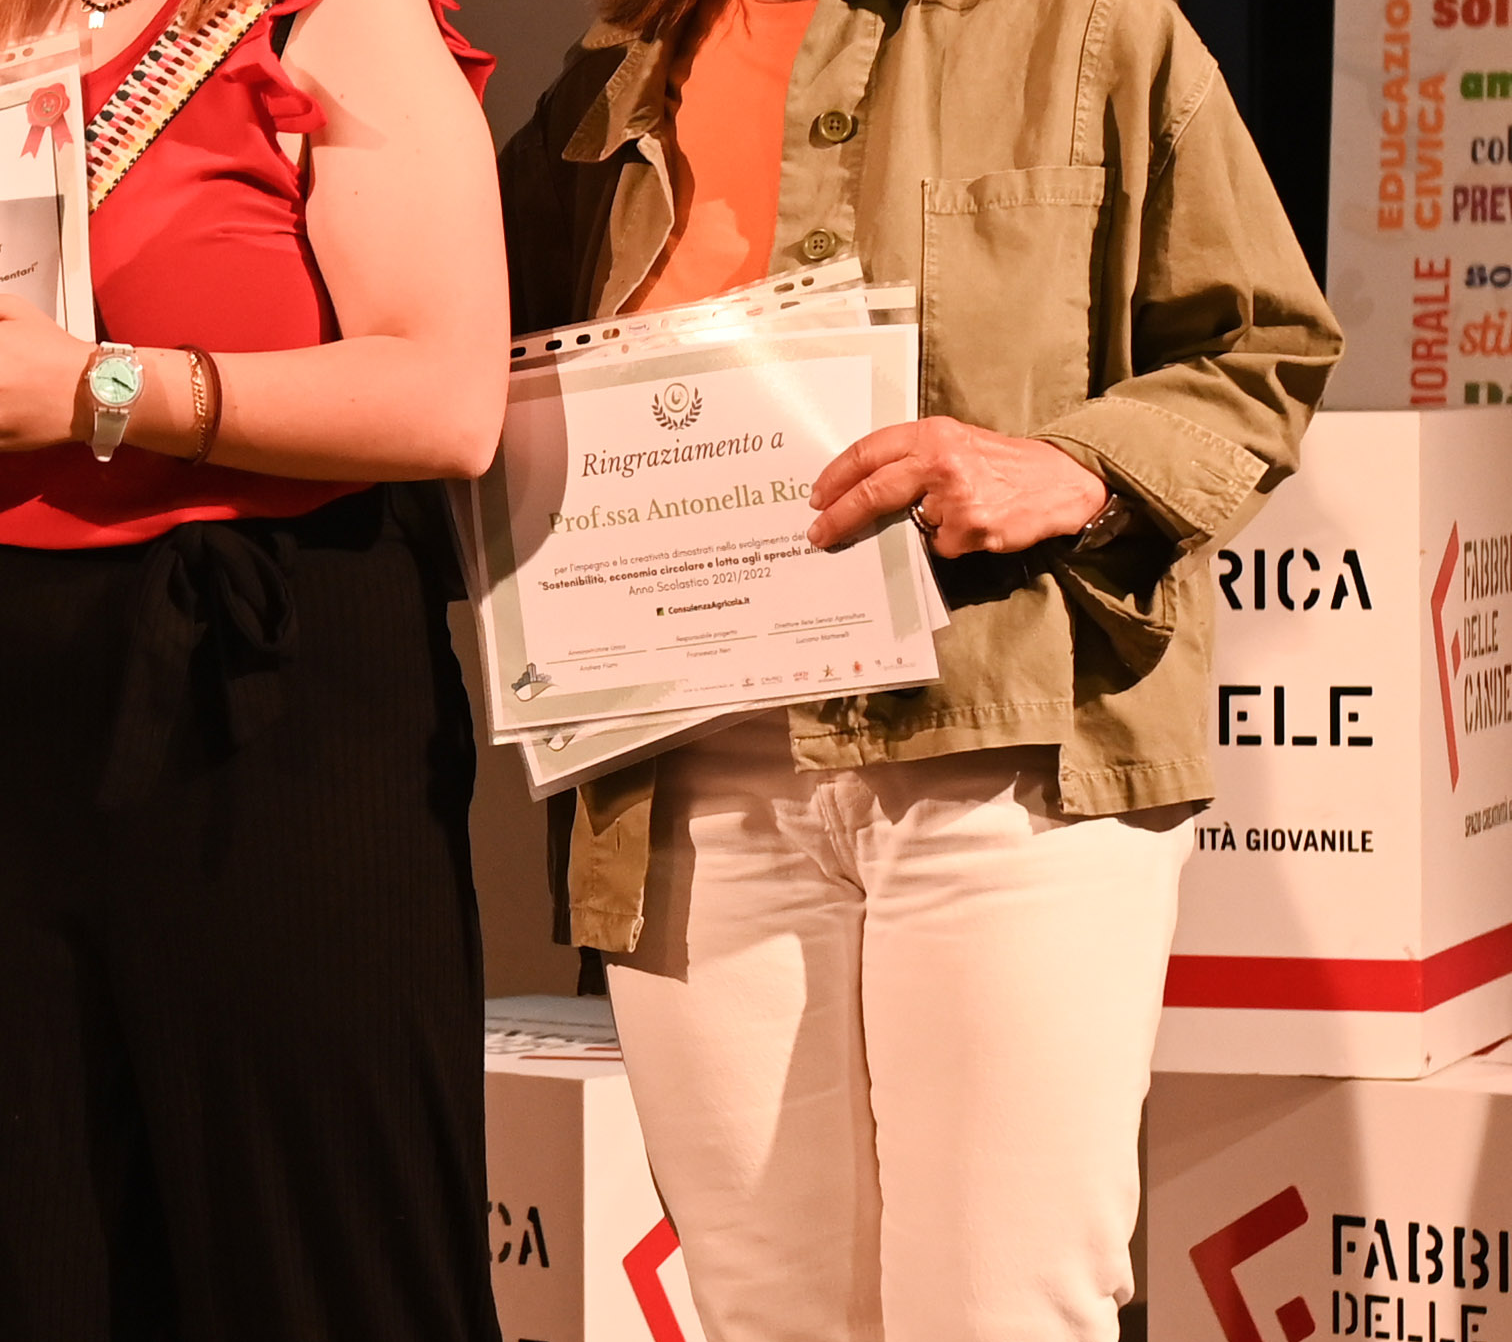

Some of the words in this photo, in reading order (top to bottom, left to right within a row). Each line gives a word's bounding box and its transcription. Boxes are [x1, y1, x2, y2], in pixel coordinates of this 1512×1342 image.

[1414, 71, 1447, 231] CIVICA
[1409, 256, 1452, 405] ORALE
[579, 432, 765, 478] Ringraziamento
[769, 431, 785, 449] a
[547, 505, 641, 535] Prof.ssa
[645, 484, 765, 522] Antonella
[768, 477, 814, 505] Ric
[609, 567, 658, 582] economia
[659, 561, 705, 576] circolare
[715, 557, 739, 568] lotta
[741, 550, 762, 566] agli
[763, 546, 802, 563] sprechi
[628, 585, 654, 596] Anno
[656, 576, 710, 593] Scolastico
[711, 566, 772, 585] 2021/2022
[1463, 609, 1499, 660] DELLE
[1245, 827, 1374, 855] GIOVANILE
